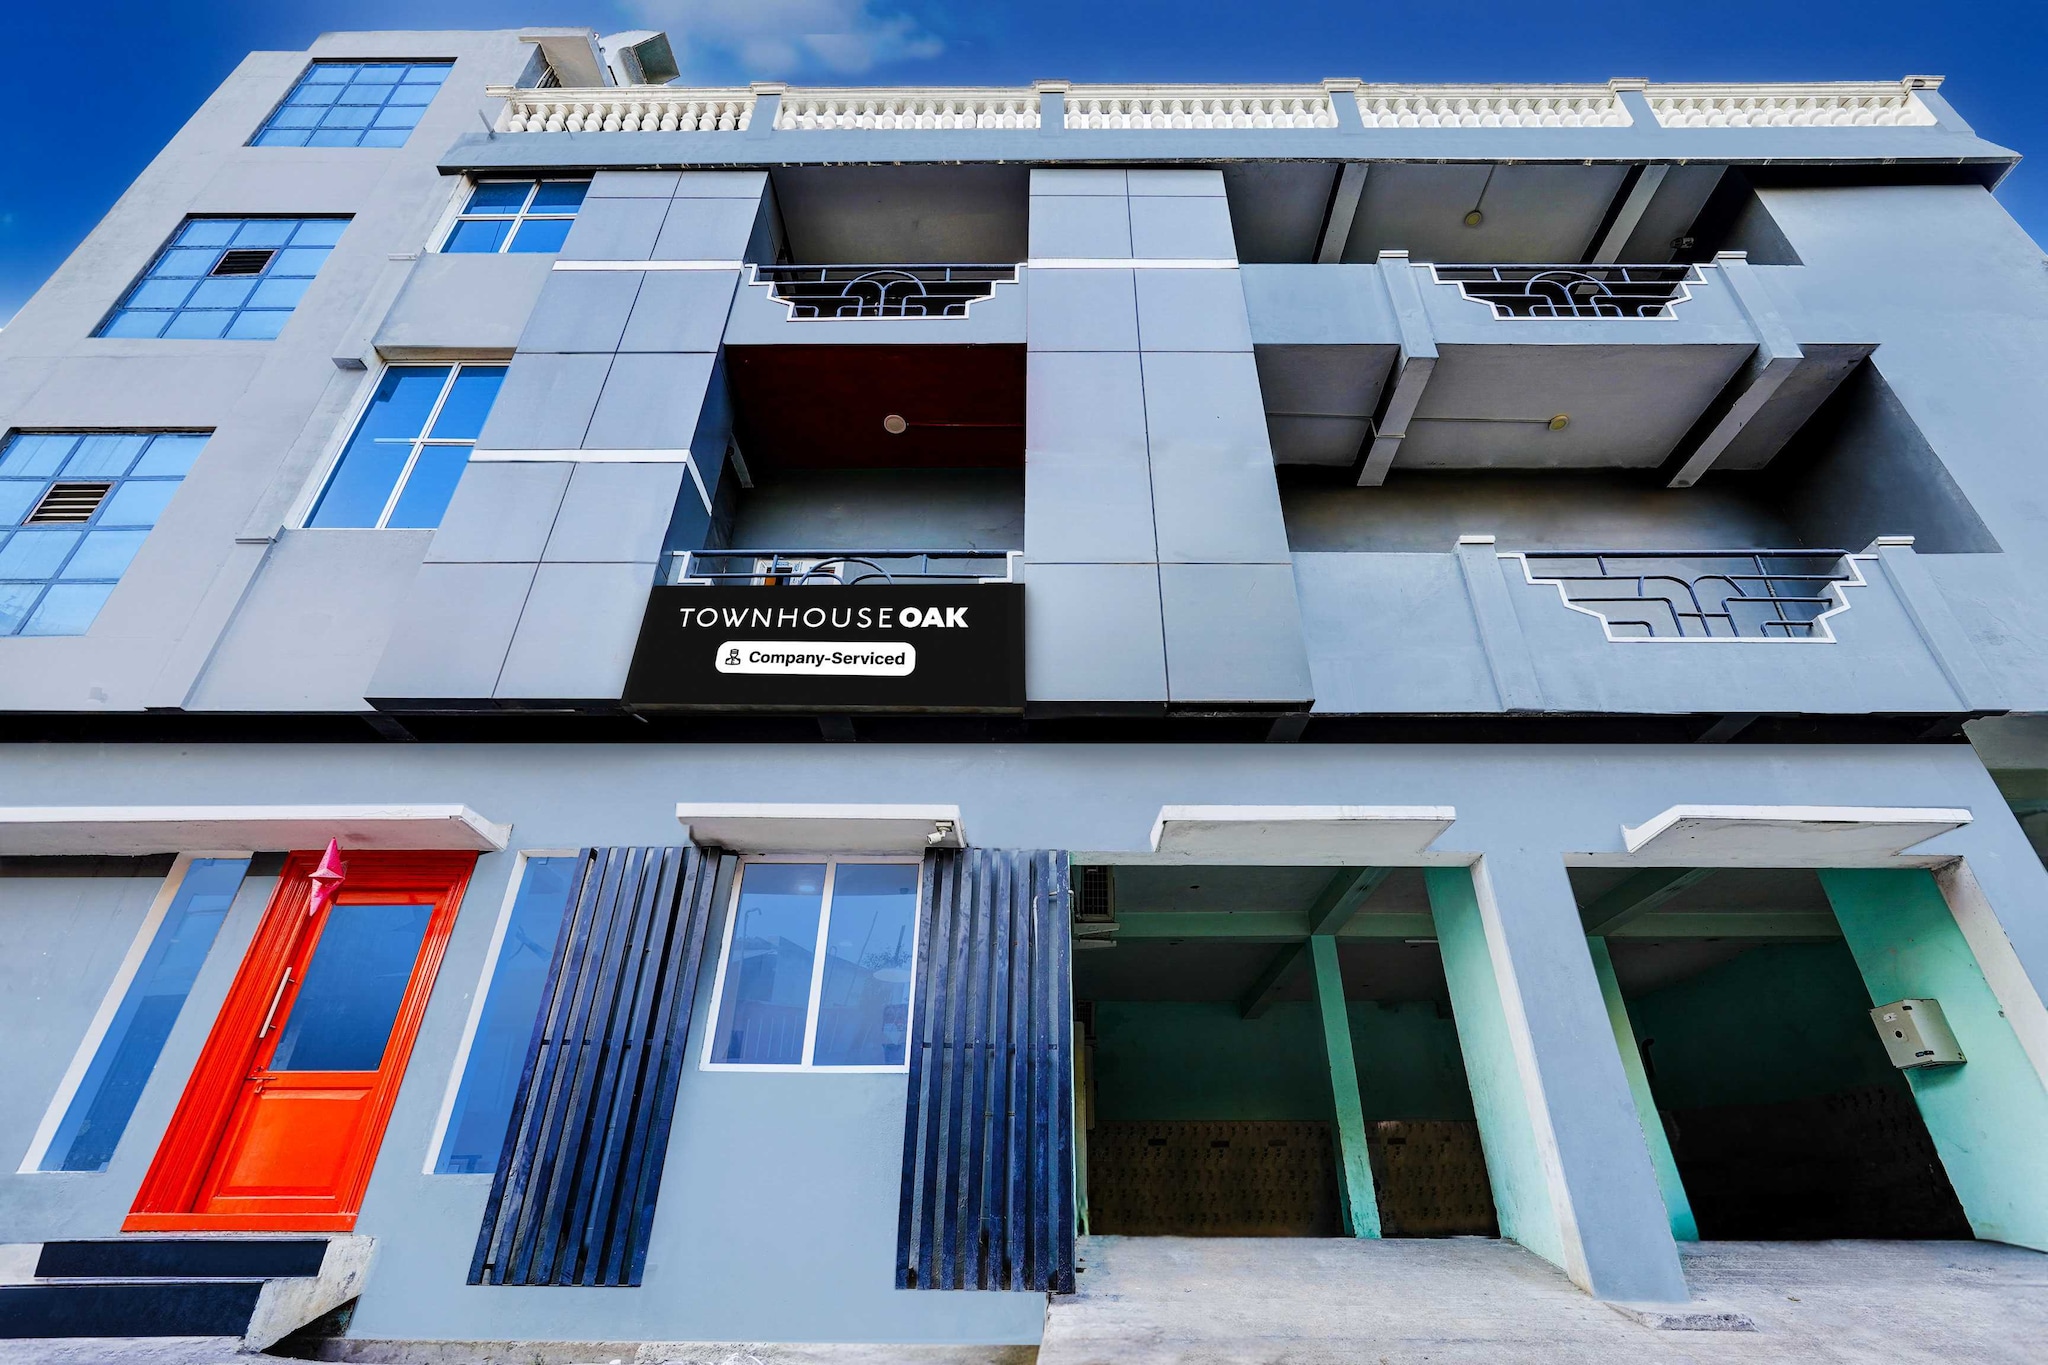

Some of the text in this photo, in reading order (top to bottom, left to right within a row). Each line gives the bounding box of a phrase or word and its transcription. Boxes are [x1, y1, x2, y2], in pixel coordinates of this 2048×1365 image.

[680, 607, 968, 628] TOWNHOUSE OAK
[749, 651, 905, 667] Company-Serviced
